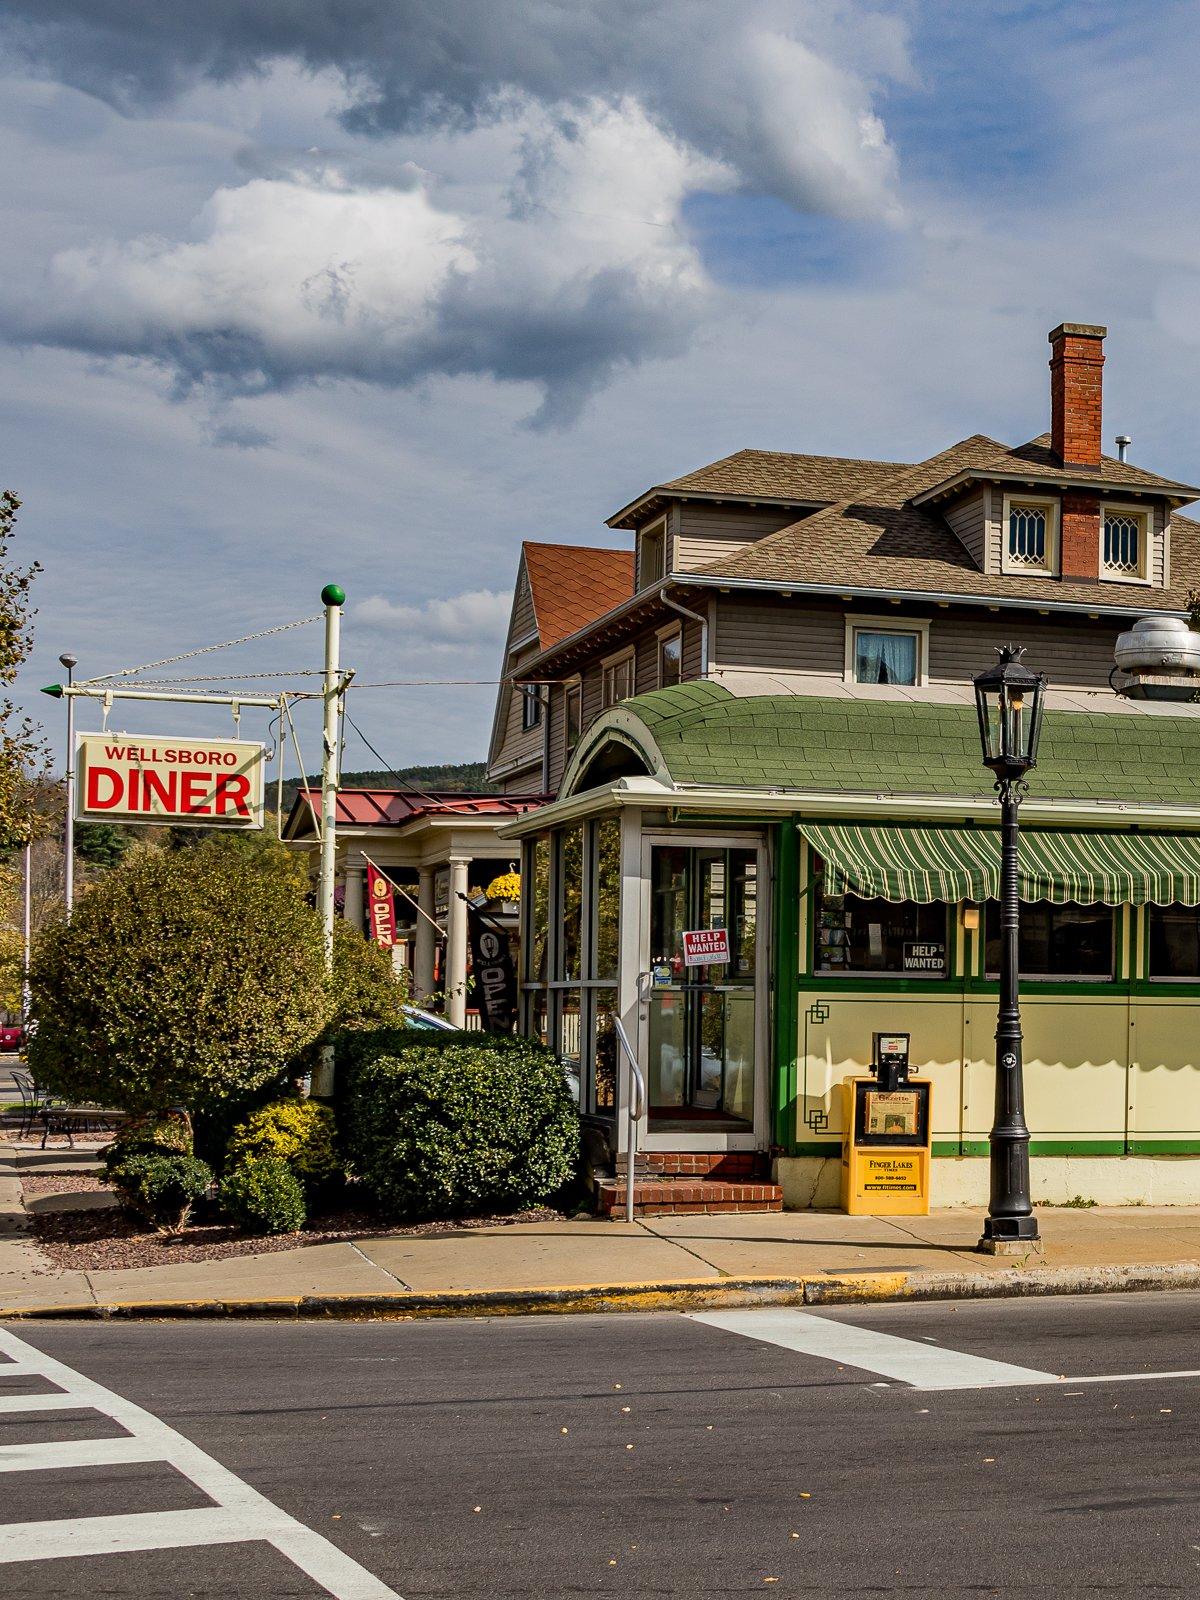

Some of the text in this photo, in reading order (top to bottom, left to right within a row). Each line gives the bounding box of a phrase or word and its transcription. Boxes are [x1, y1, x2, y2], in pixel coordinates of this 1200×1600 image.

[104, 745, 237, 766] WELLSBORO
[87, 766, 251, 816] DINER
[373, 903, 393, 946] OPEN
[692, 932, 721, 943] HELP
[688, 941, 726, 953] WANTED
[912, 946, 937, 957] HELP
[905, 957, 944, 969] WANTED
[481, 967, 511, 1033] OPEN
[869, 1160, 913, 1169] FINGER LAKES
